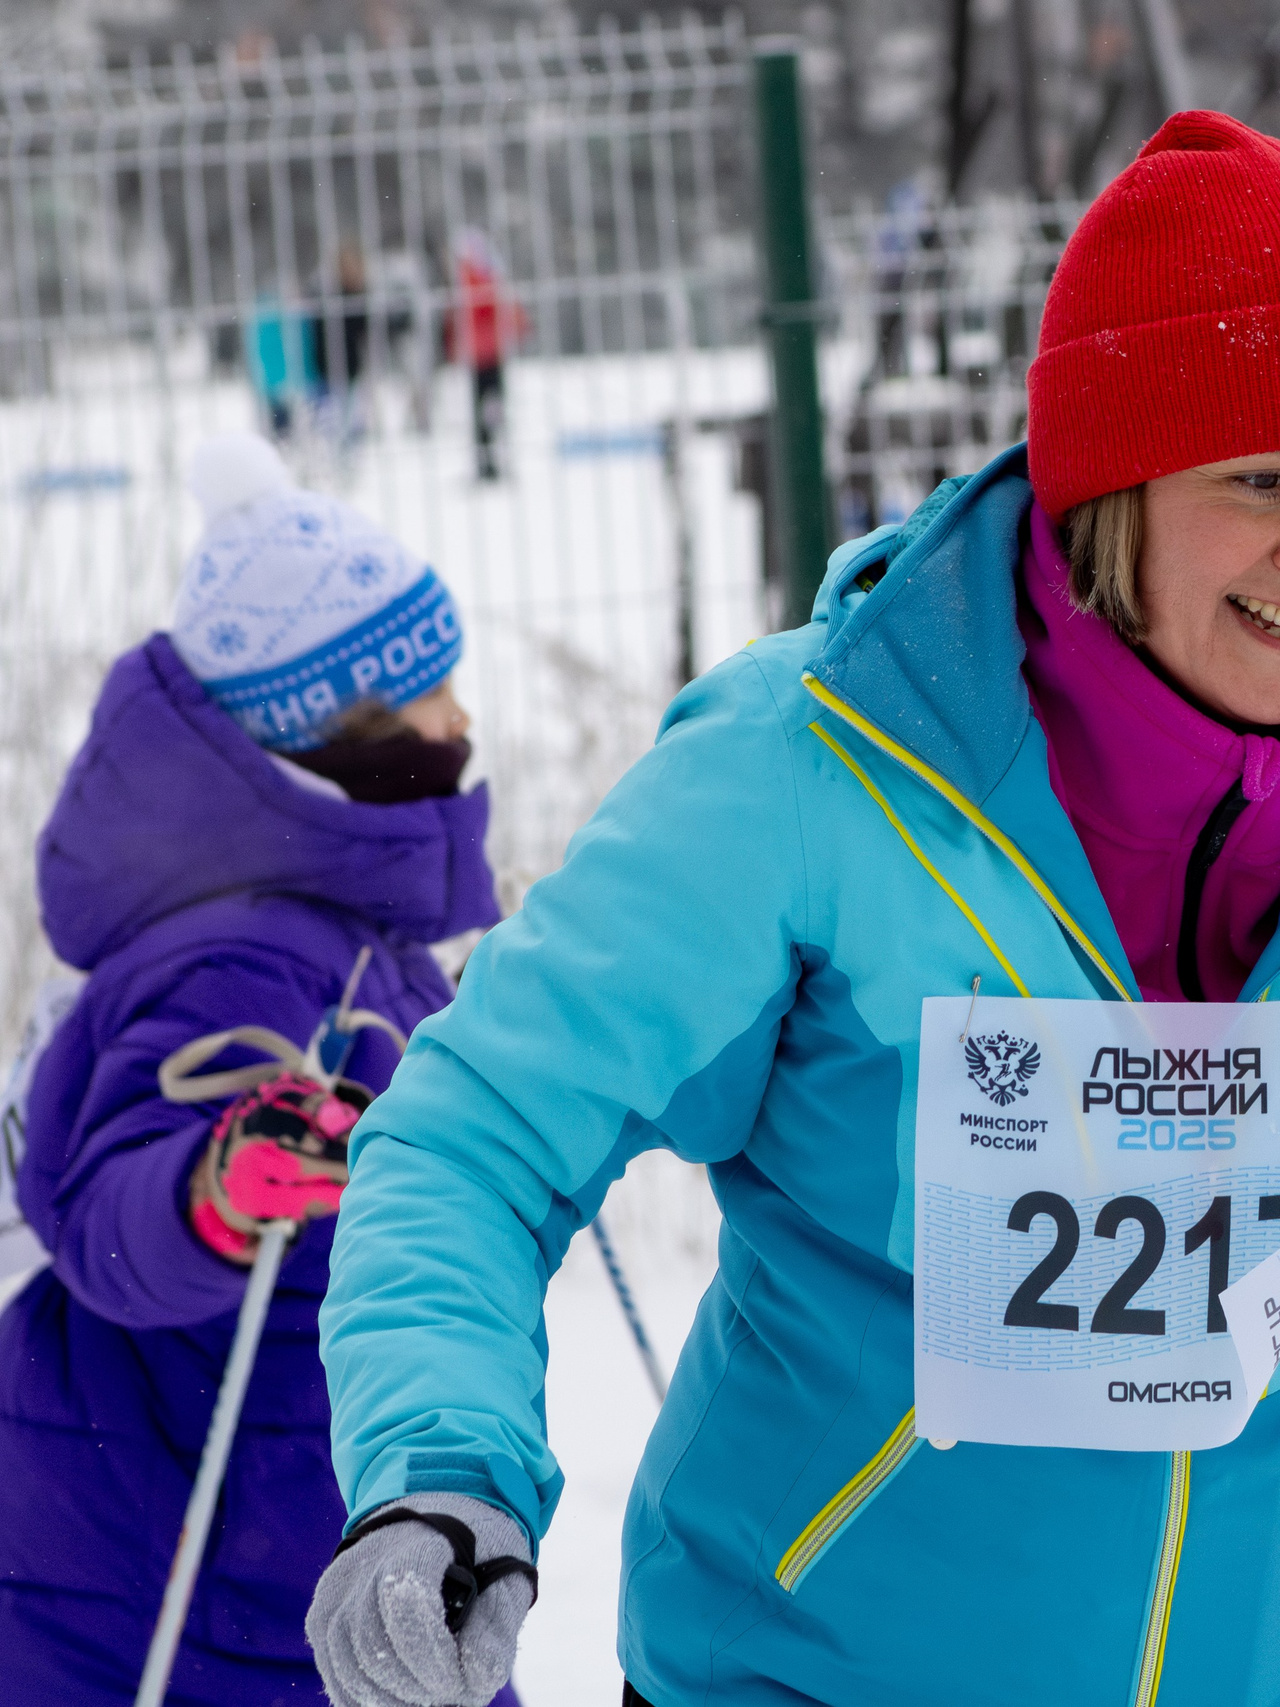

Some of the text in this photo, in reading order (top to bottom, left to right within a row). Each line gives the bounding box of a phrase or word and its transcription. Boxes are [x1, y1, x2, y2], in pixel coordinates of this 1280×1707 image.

[1090, 1046, 1262, 1081] ЛЫЖНЯ
[1082, 1081, 1268, 1116] РОССИИ
[960, 1112, 1049, 1133] МИНСПОРТ
[1117, 1118, 1237, 1151] 2025
[970, 1132, 1037, 1152] РОССИИ
[1107, 1379, 1232, 1404] ОМСКАЯ
